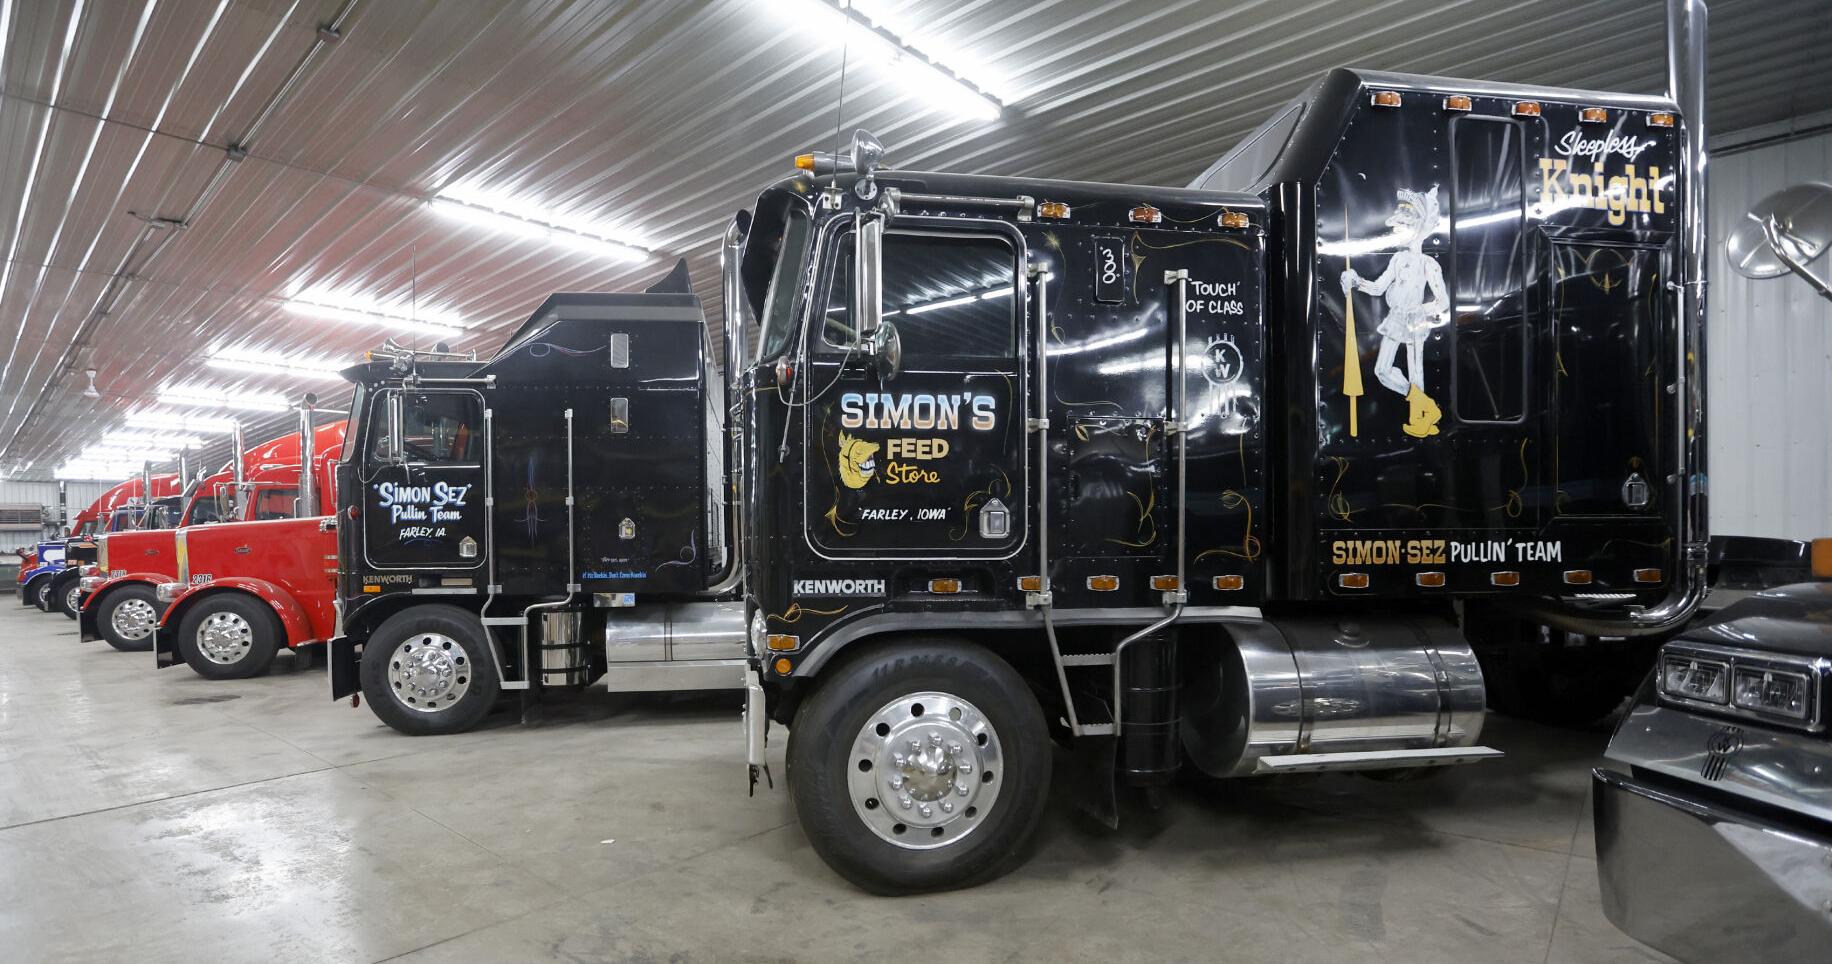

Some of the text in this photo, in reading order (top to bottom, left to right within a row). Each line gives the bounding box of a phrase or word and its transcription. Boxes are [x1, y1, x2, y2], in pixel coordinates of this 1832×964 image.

[1555, 129, 1657, 163] Sleepless
[1539, 158, 1665, 226] Knight
[1186, 300, 1243, 315] OF CLASS
[841, 392, 996, 430] SIMON'S
[887, 437, 949, 461] FEED
[886, 461, 941, 485] Store
[391, 504, 462, 525] Pullin Team
[1515, 541, 1562, 562] TEAM
[363, 575, 413, 585] KENWORTH
[793, 580, 885, 594] KENWORTH
